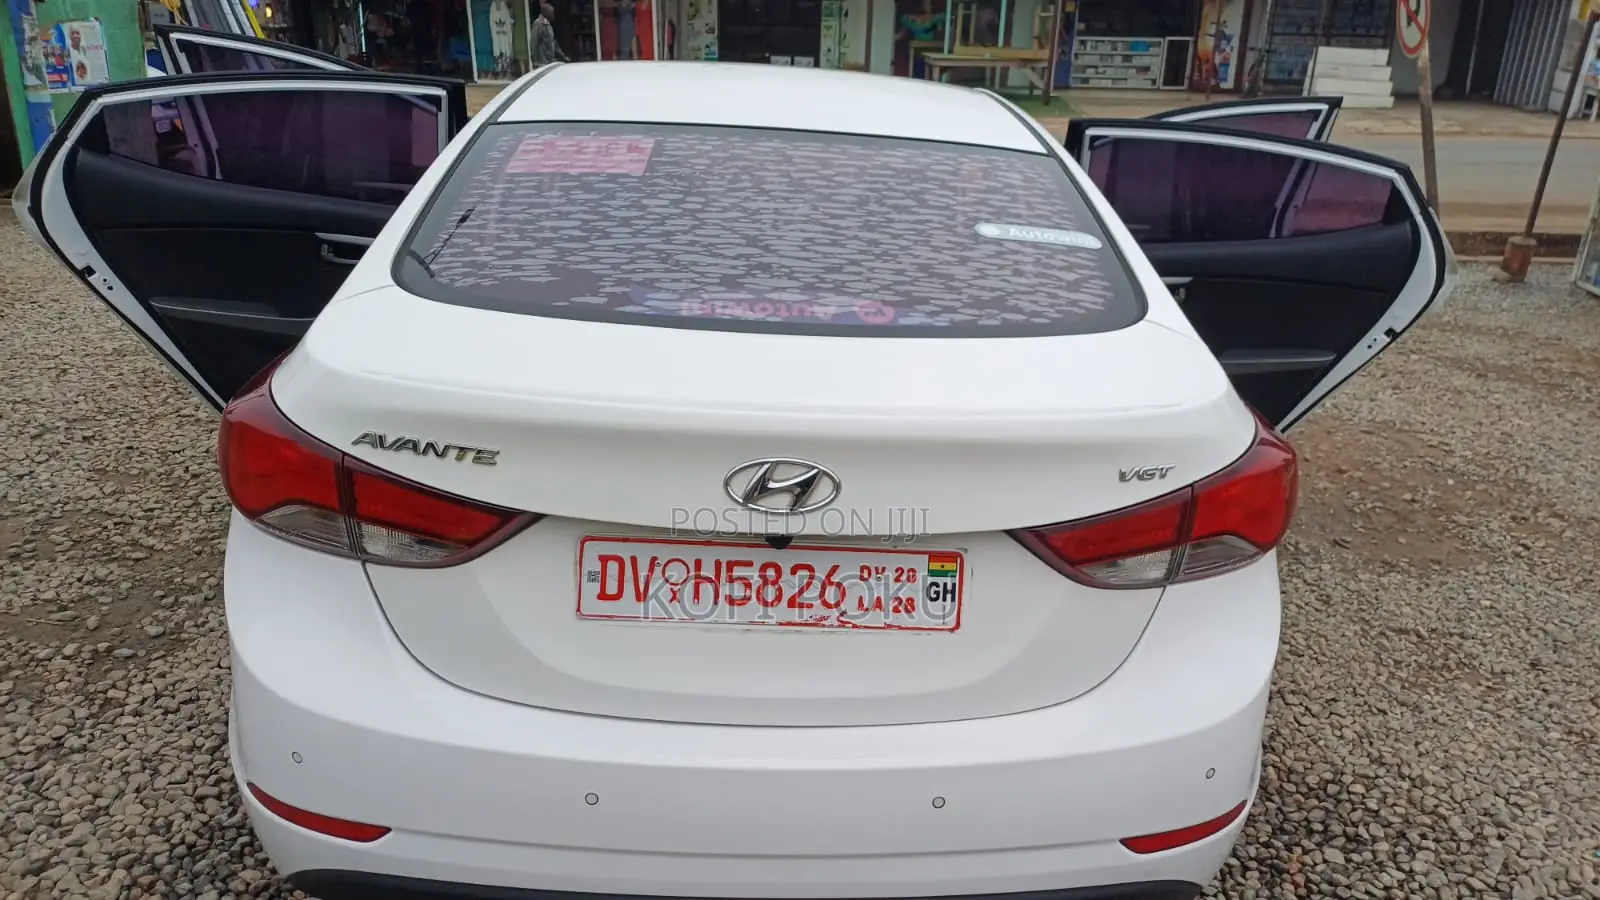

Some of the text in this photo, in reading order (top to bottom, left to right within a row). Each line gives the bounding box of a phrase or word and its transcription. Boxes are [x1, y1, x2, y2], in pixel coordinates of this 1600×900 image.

[351, 431, 500, 466] AVANTE
[1119, 464, 1176, 482] VGT
[927, 581, 956, 602] GH
